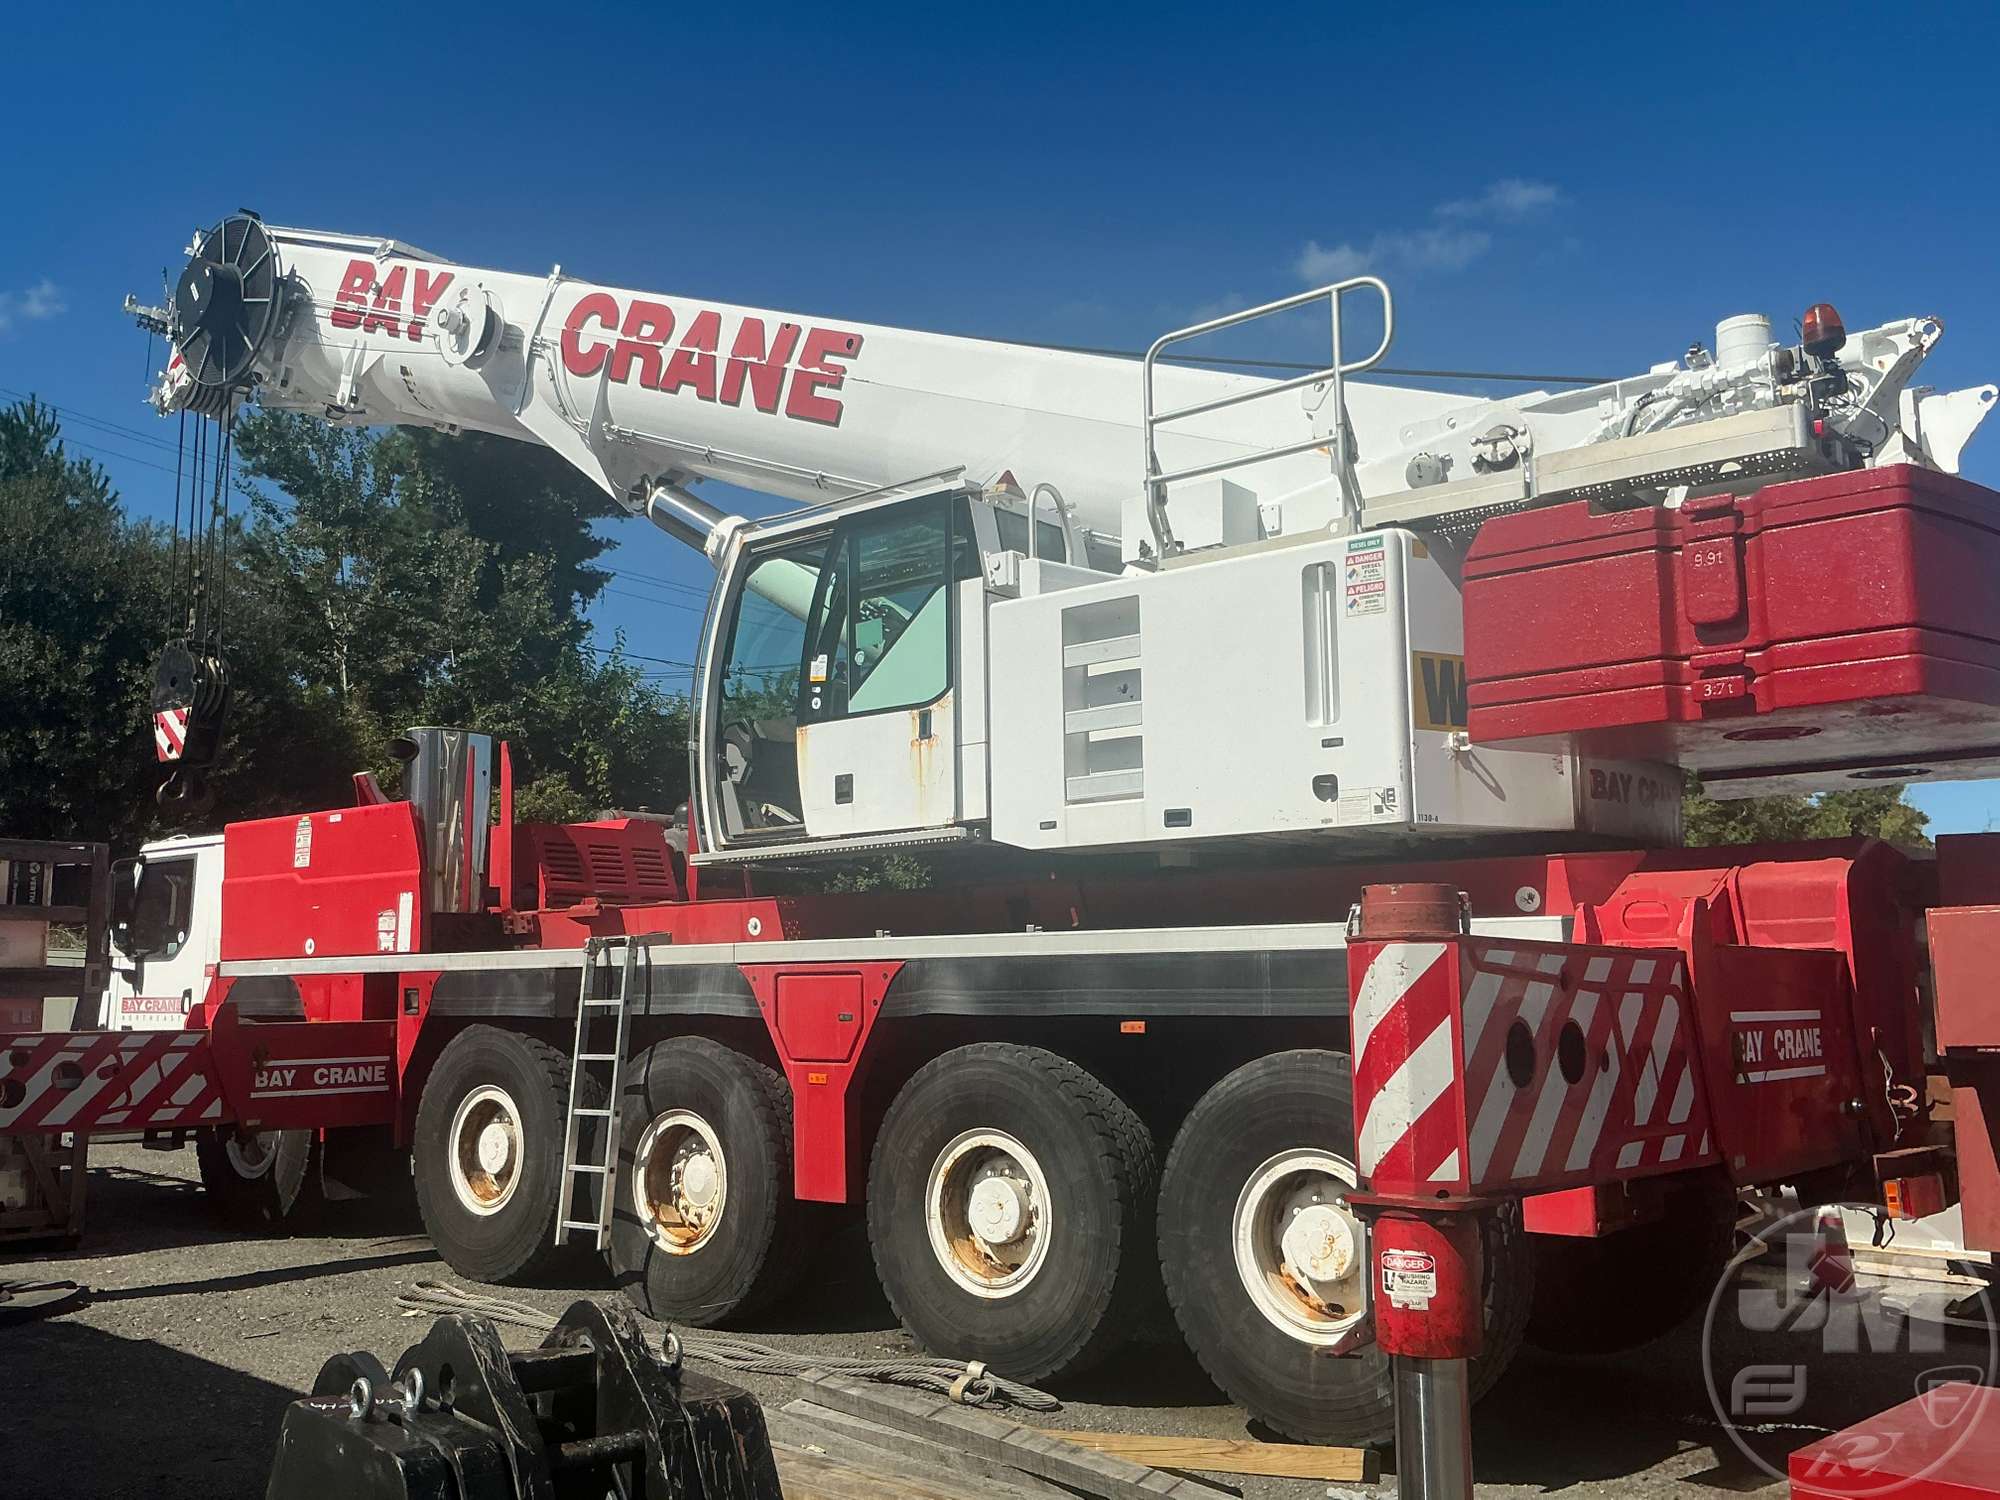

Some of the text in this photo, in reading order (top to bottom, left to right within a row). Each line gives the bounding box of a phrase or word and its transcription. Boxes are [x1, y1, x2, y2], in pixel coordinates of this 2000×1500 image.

[330, 258, 864, 428] BAY CRANE
[1355, 552, 1383, 564] DANGER
[1355, 582, 1384, 594] PELIGRO
[1589, 768, 1633, 804] BAY
[122, 998, 142, 1011] BAY
[1774, 1027, 1822, 1060] CRANE
[255, 1065, 387, 1088] BAY CRANE
